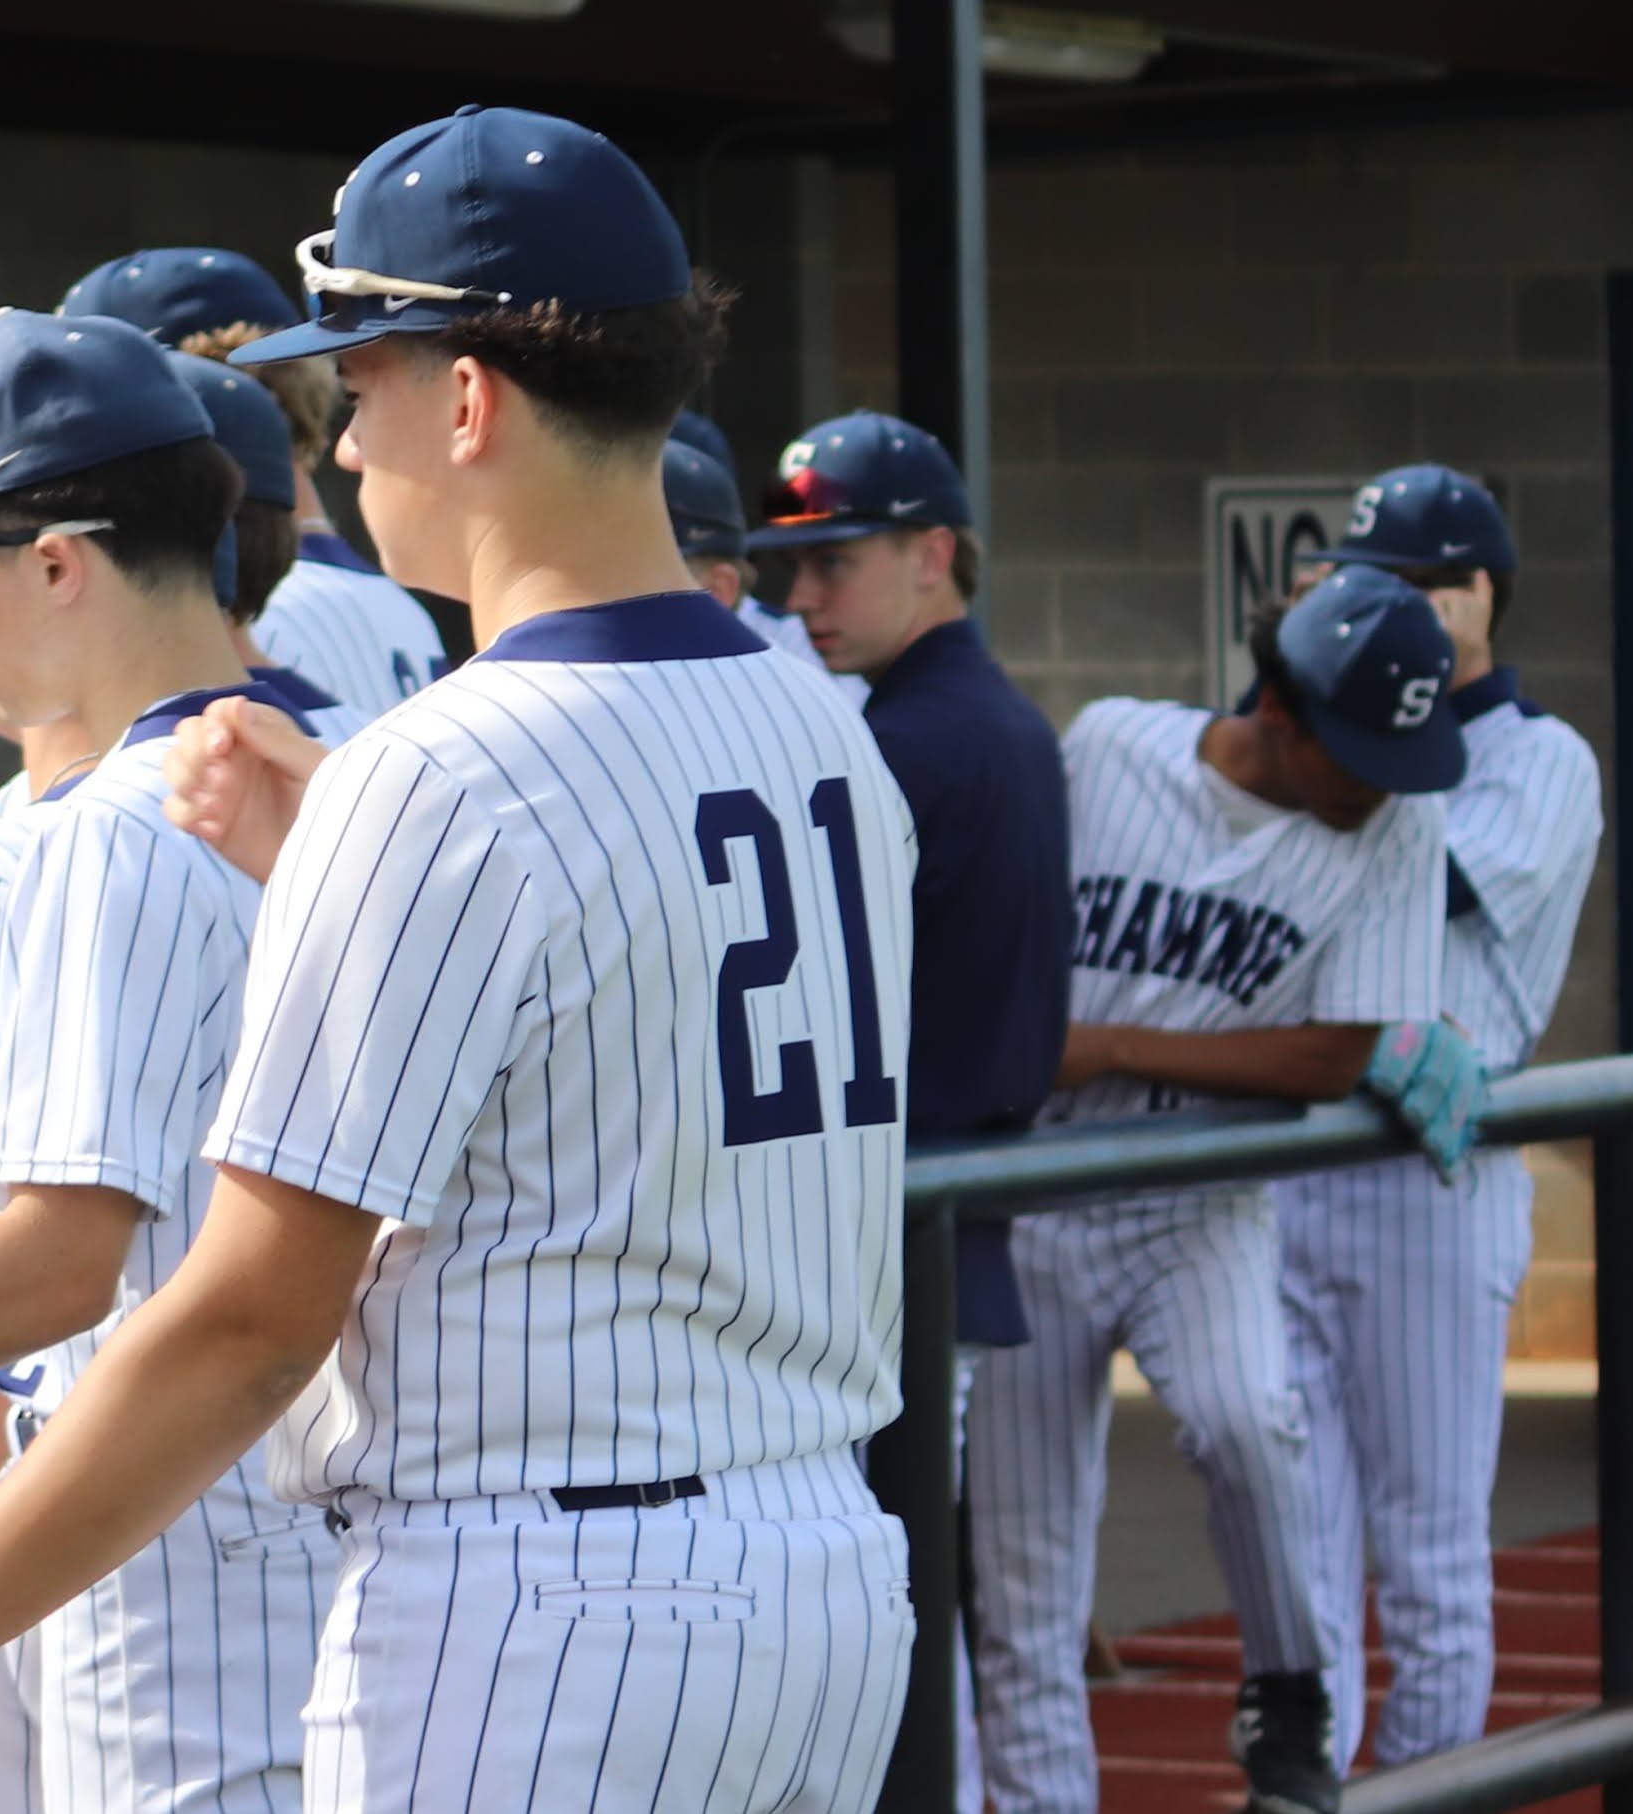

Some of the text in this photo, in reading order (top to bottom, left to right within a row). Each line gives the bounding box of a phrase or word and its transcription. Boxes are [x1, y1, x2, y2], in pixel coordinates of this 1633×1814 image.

[1347, 485, 1383, 537] S
[1392, 677, 1440, 727] S
[694, 776, 897, 1147] 21
